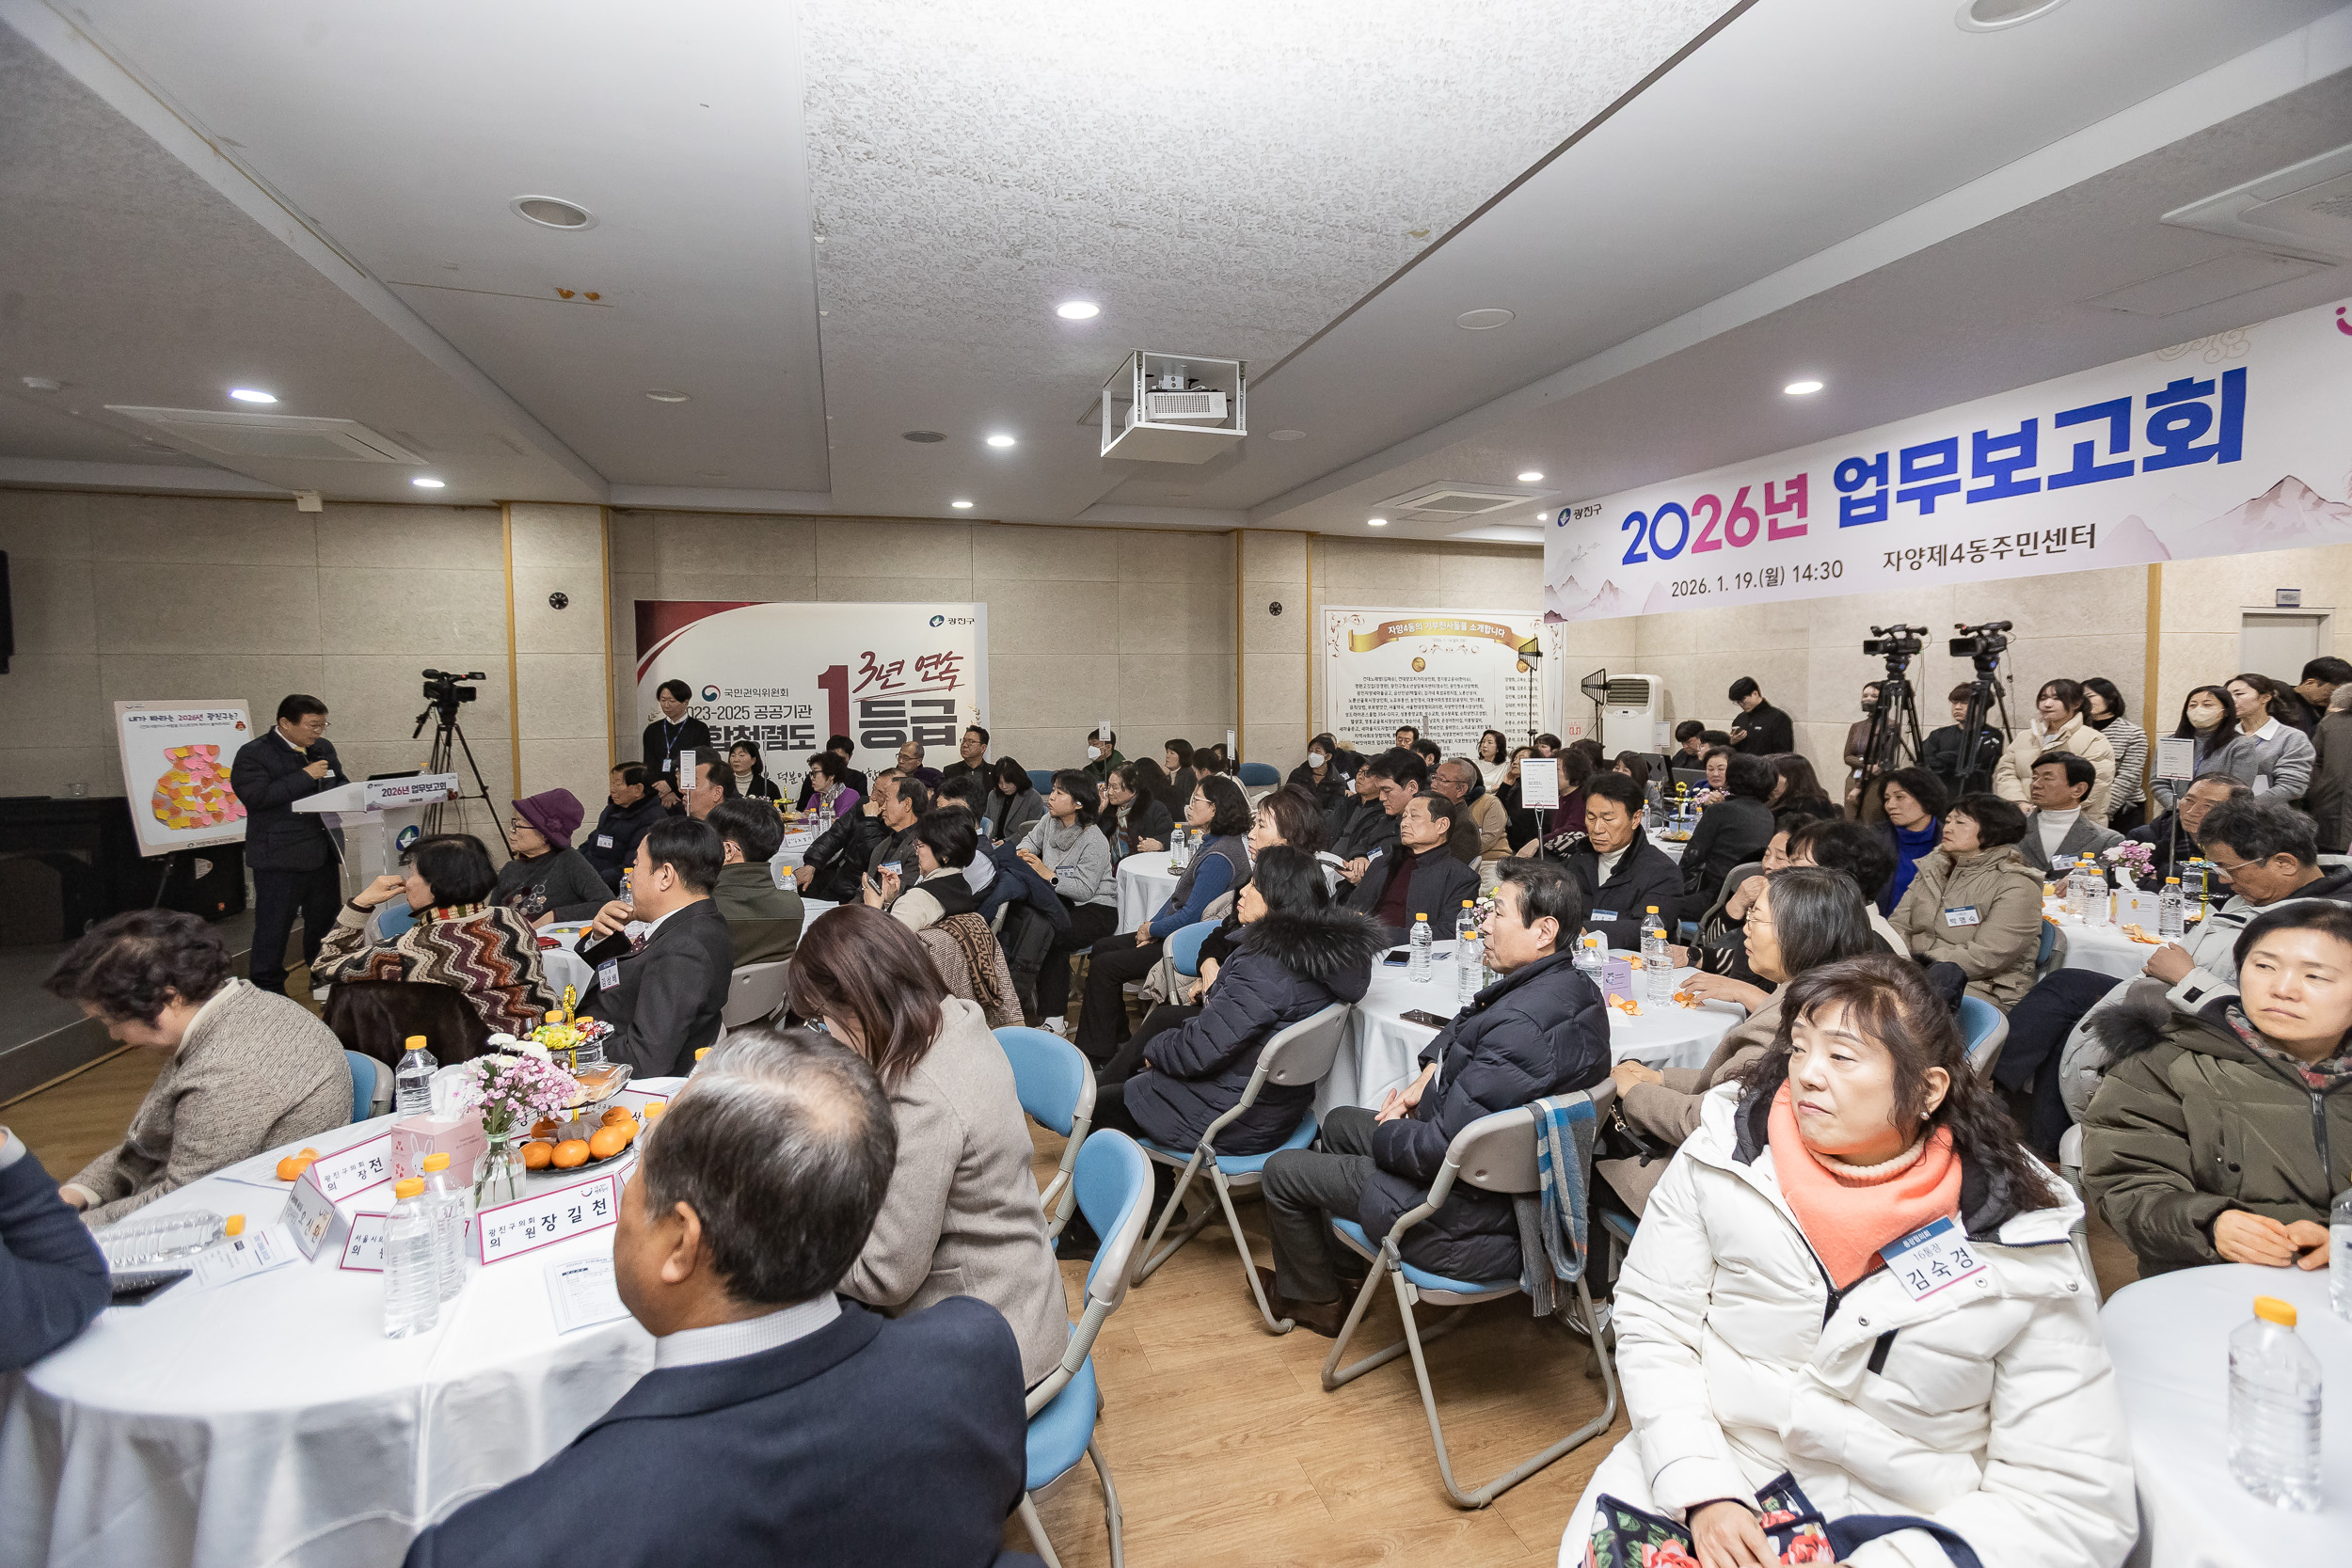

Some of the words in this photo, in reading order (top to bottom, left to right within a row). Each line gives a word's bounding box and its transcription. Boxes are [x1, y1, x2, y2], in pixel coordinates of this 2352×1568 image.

[1622, 472, 1808, 565] 2026년
[1833, 366, 2248, 529] 업무보고회
[1573, 503, 1603, 520] 광진구
[1883, 523, 2096, 573] 자양제4동주민센터
[1672, 578, 1711, 597] 2026.
[1717, 576, 1729, 592] 1.
[1735, 566, 1786, 589] 19.(월)
[1792, 560, 1843, 583] 14:30
[947, 617, 976, 626] 광진구
[1388, 623, 1422, 635] 자양4동의
[1470, 624, 1505, 638] 소개합니다
[852, 651, 906, 693] 3년
[915, 651, 963, 691] 연속
[724, 688, 789, 697] 국민권익위원회
[178, 713, 204, 721] 2026년
[687, 705, 750, 721] 023-2025
[754, 705, 813, 720] 공공기관
[709, 724, 817, 752] 합청렴도
[381, 785, 409, 798] 2026년
[411, 782, 447, 794] 업무보고회
[324, 1161, 365, 1182] 광진구의회
[541, 1197, 607, 1232] 장길천
[488, 1216, 535, 1237] 광진구의회
[1913, 1243, 1942, 1261] 16통장
[1906, 1246, 1974, 1291] 김숙경
